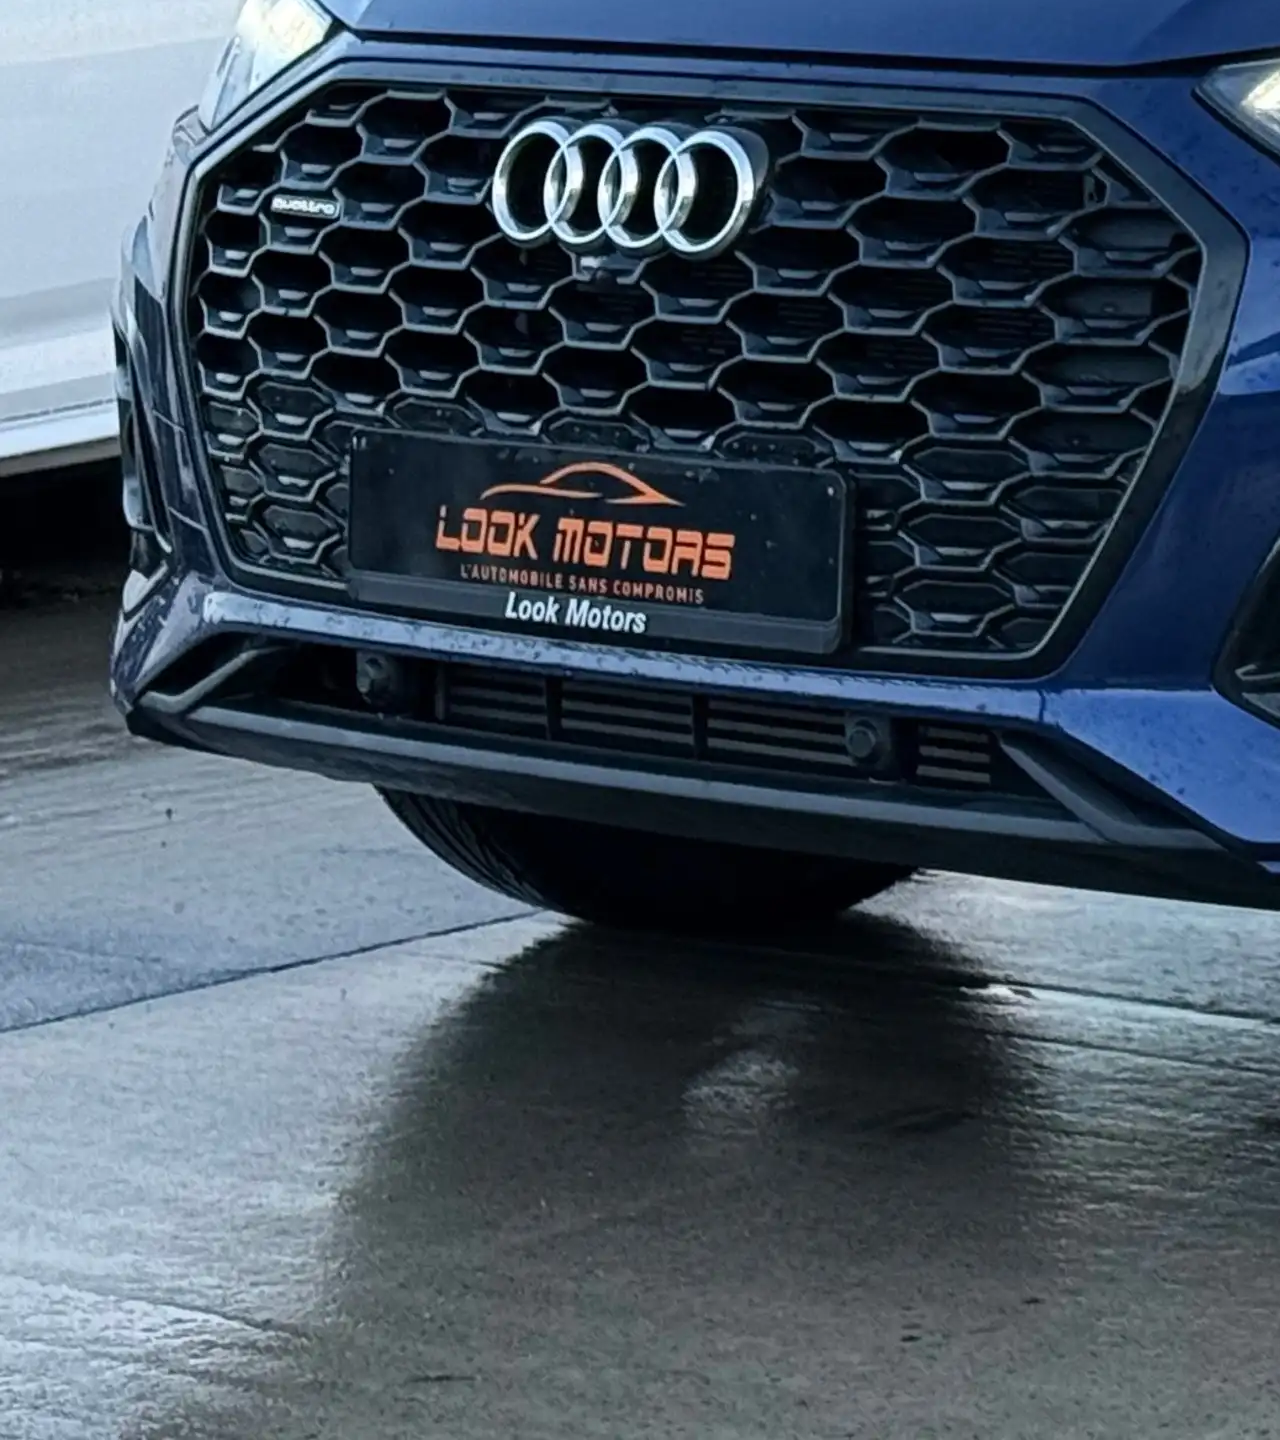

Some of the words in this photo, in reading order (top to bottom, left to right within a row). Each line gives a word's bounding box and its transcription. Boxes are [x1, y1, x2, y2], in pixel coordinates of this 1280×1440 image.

[436, 504, 539, 560] LOOK
[553, 517, 736, 581] MOTORS
[460, 563, 563, 589] L'AUTOMOBILE
[568, 575, 608, 594] SANS
[613, 580, 704, 605] COMPROMIS
[504, 591, 560, 624] Look
[565, 597, 647, 634] Motors
